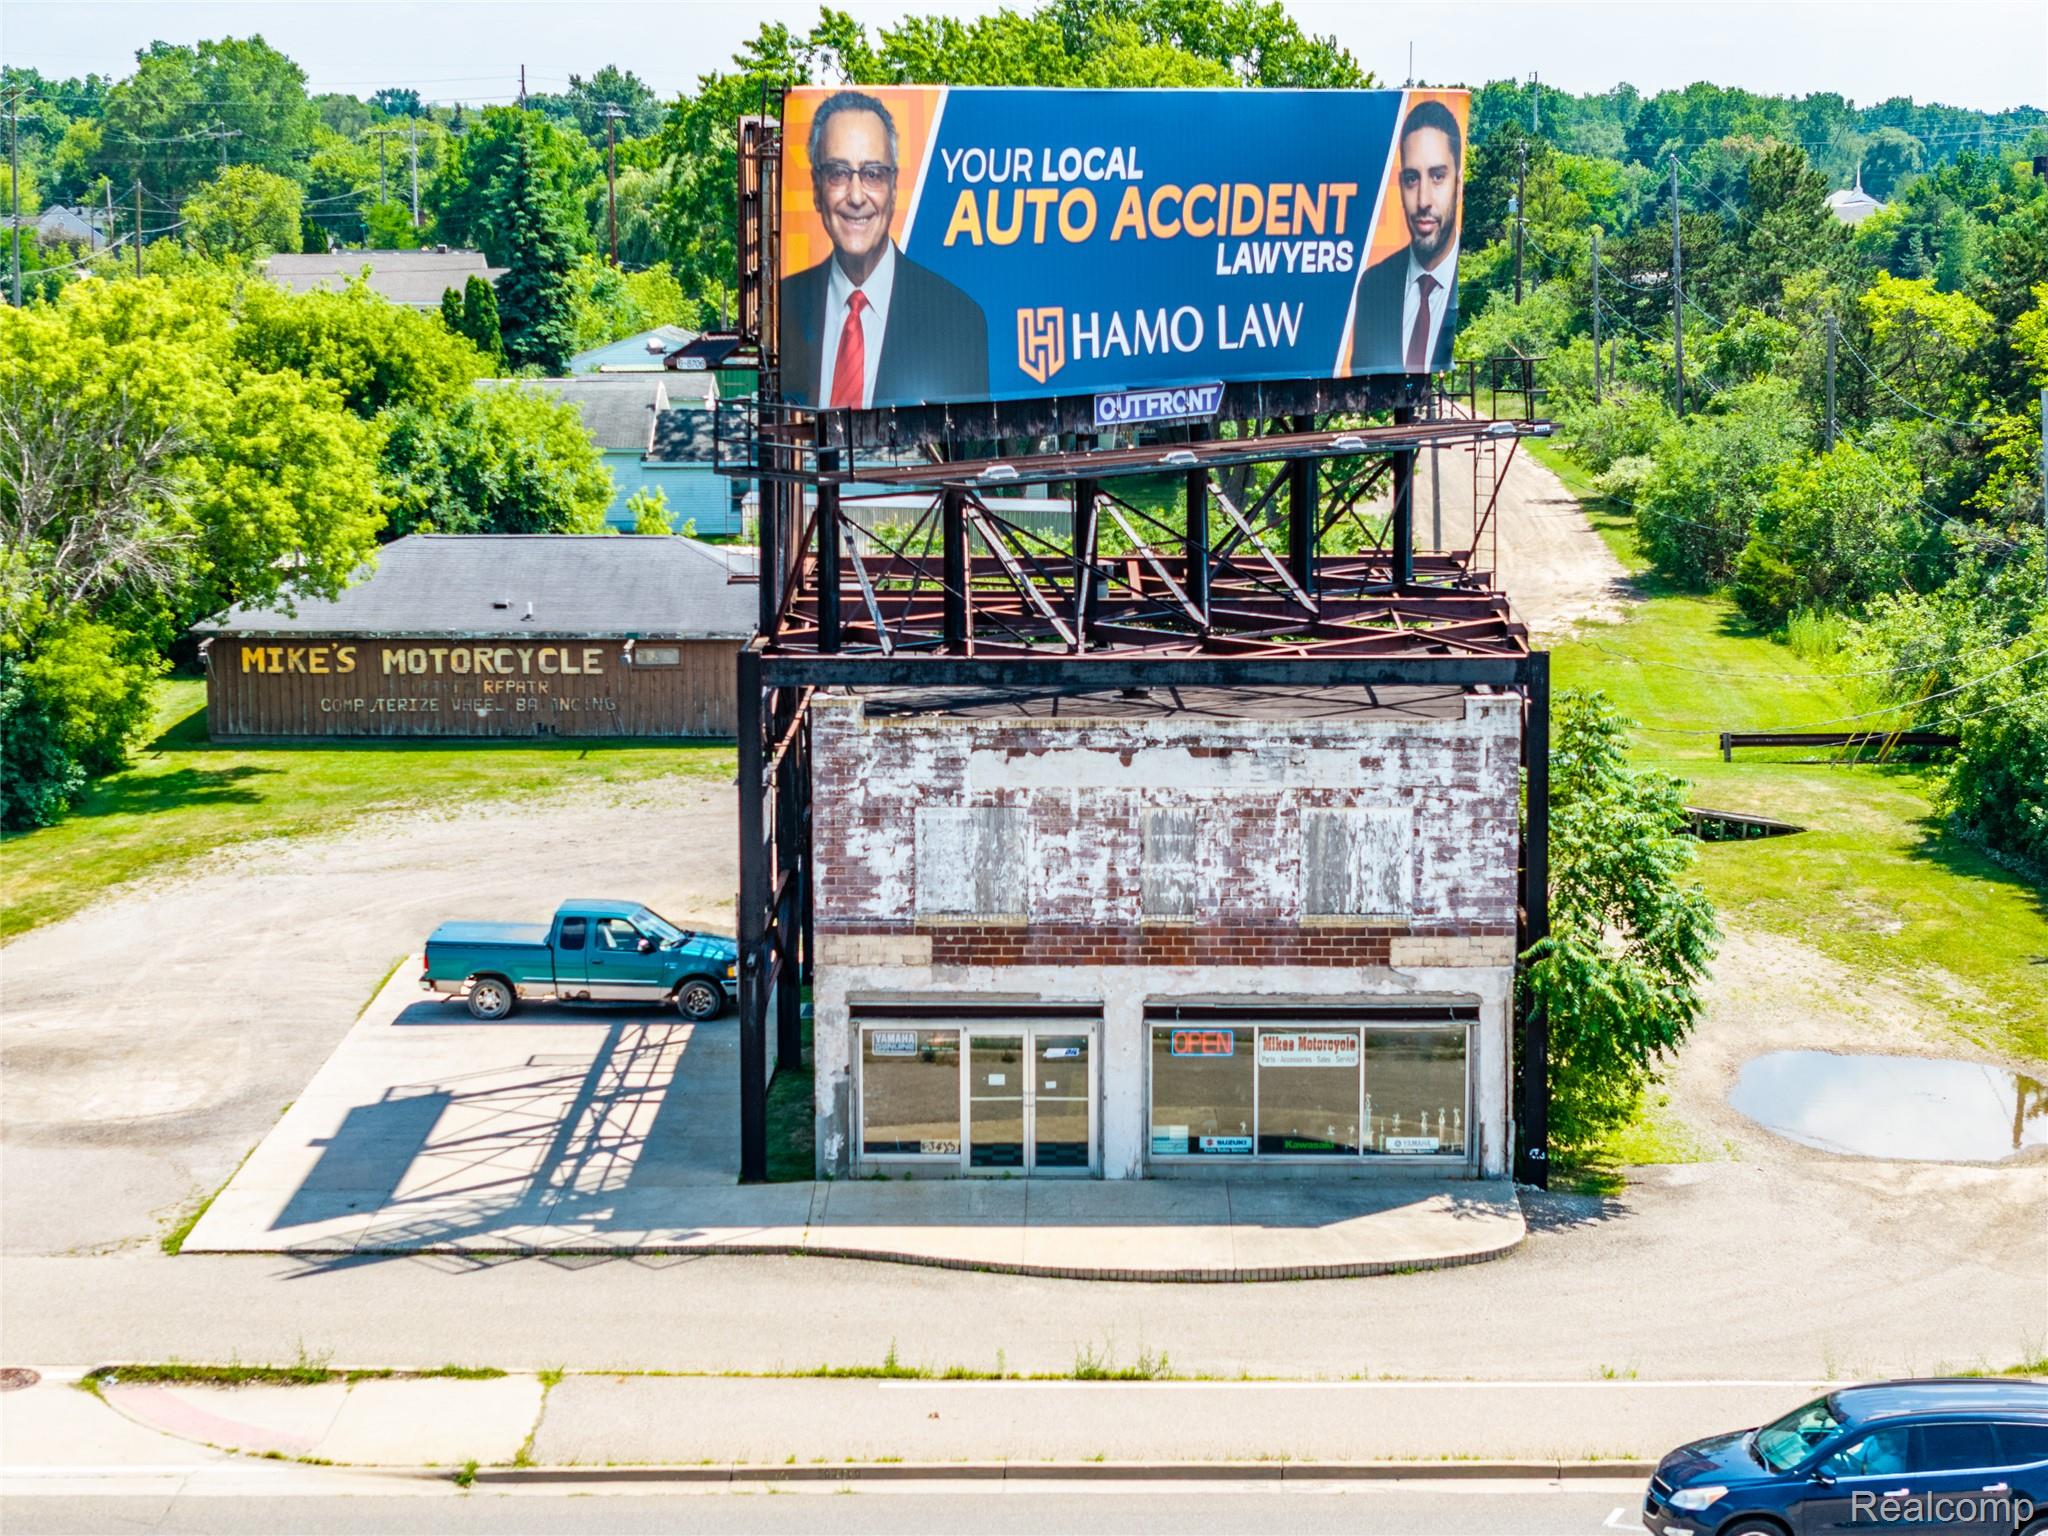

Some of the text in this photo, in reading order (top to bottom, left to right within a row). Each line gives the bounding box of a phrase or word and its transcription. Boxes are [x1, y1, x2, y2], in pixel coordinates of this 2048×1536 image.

[941, 146, 1144, 184] YOUR LOCAL
[943, 182, 1357, 247] AUTO ACCIDENT
[1215, 240, 1354, 276] LAWYERS
[1072, 302, 1304, 360] HAMO LAW
[1099, 386, 1218, 421] OUTFRONT
[241, 643, 604, 675] MIKE'S MOTORCYCLE
[320, 699, 440, 713] COMPTERIZE
[516, 697, 616, 712] BANCING
[875, 1033, 915, 1043] YAMAHA
[1173, 1031, 1232, 1053] OPEN
[1263, 1036, 1356, 1054] Mikes Motorcycle
[1284, 1140, 1335, 1150] Kawasaki
